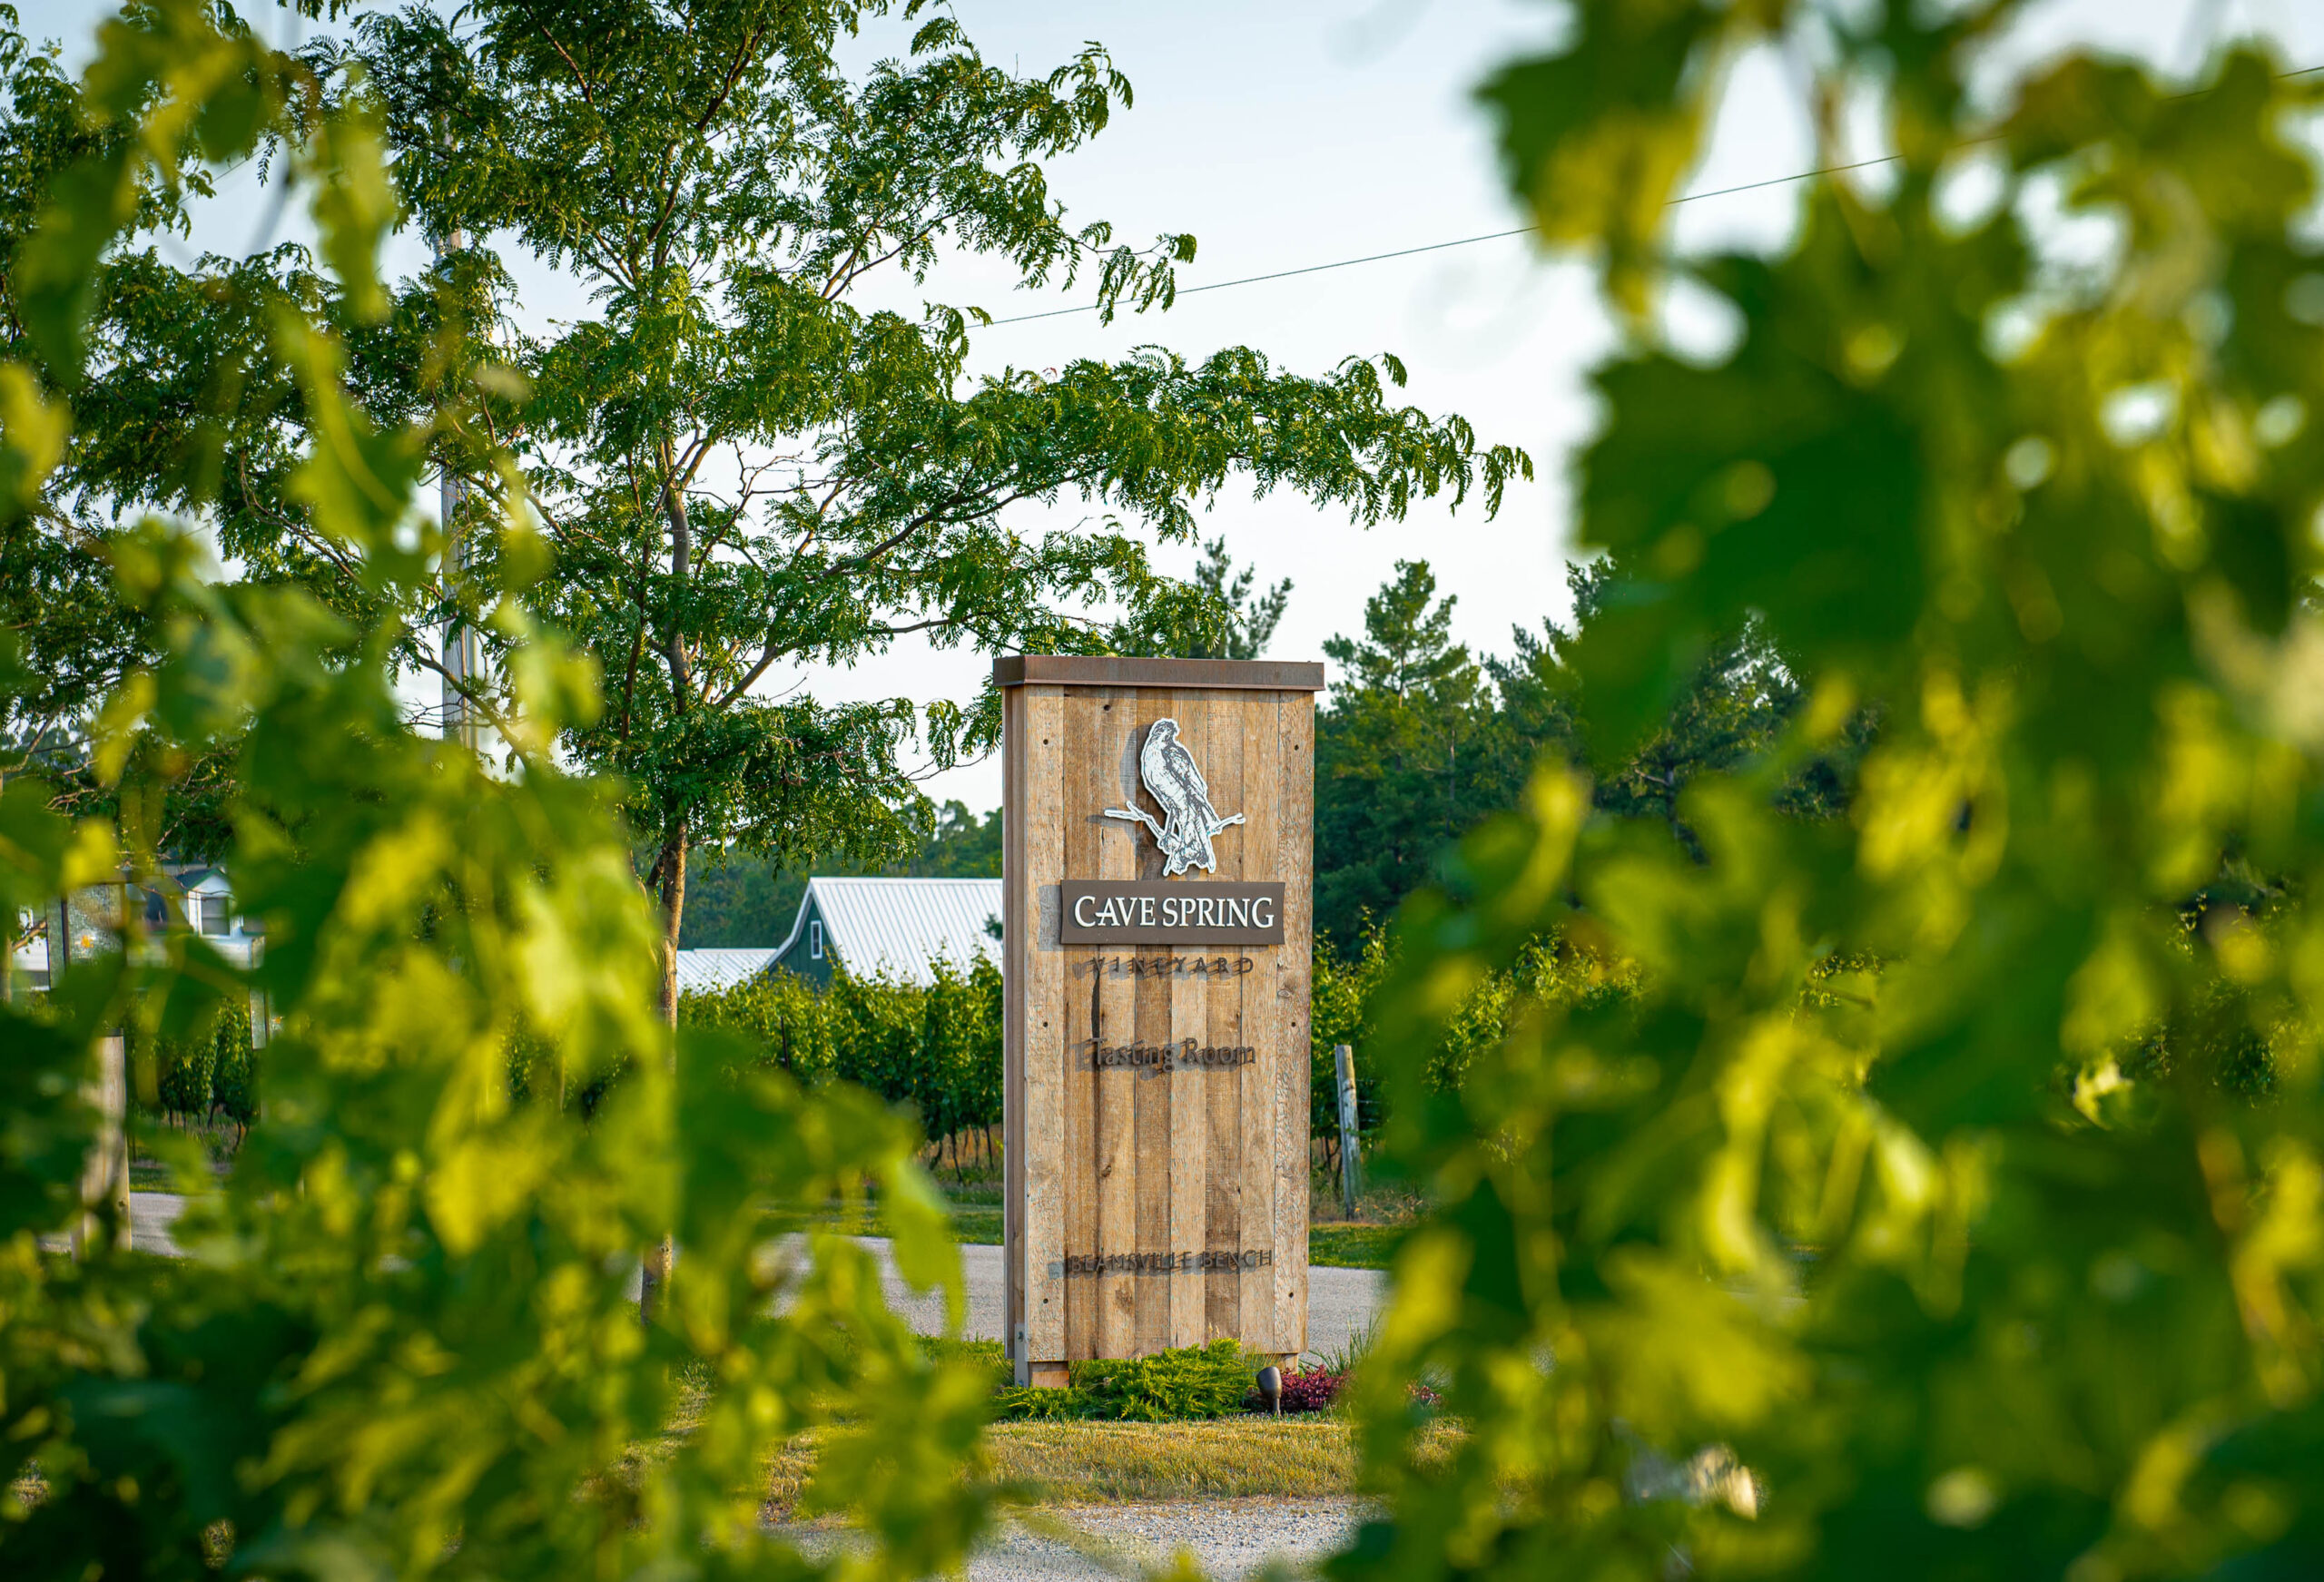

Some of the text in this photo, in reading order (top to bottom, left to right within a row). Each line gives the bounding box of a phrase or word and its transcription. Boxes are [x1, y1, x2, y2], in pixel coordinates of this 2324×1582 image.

[1074, 895, 1275, 929] CAVE SPRING
[1092, 956, 1255, 974] VINEYARD
[1092, 1037, 1256, 1074] Tasting Room
[1069, 1249, 1274, 1273] BEAMSVILLE BENCH
